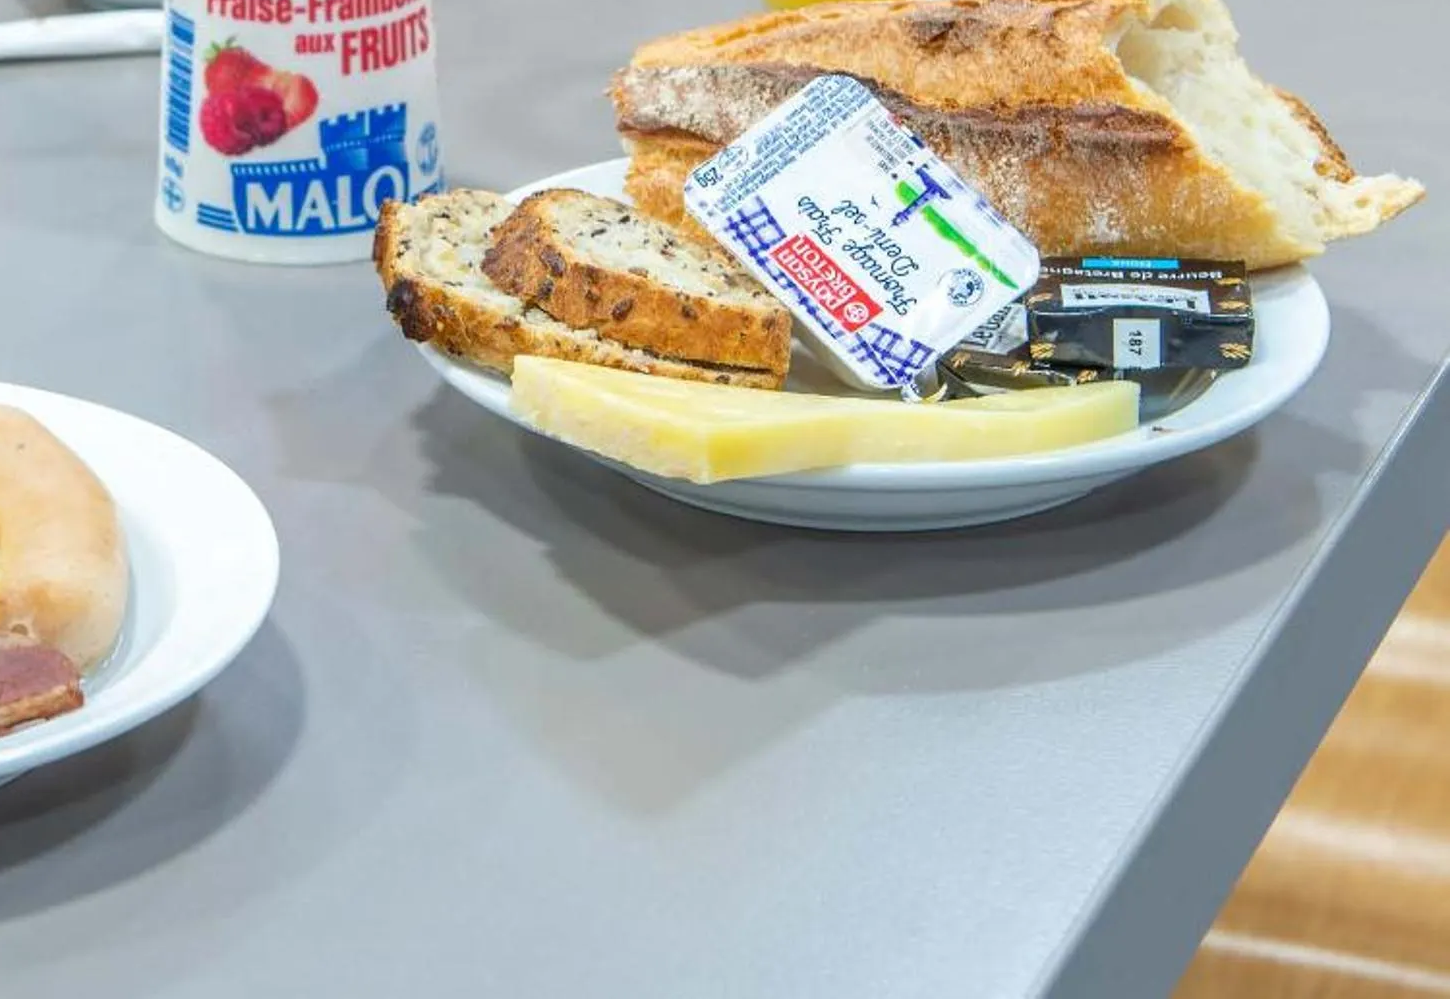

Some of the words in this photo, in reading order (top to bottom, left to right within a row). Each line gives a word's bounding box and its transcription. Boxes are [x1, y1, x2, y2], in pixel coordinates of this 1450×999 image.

[295, 31, 335, 54] aux
[341, 6, 429, 76] FRUITS
[245, 165, 405, 231] MALO
[798, 195, 842, 245] Frais
[831, 199, 919, 277] Demi-sel
[842, 239, 918, 316] Fromage
[1130, 270, 1154, 281] de
[1128, 329, 1143, 356] 187
